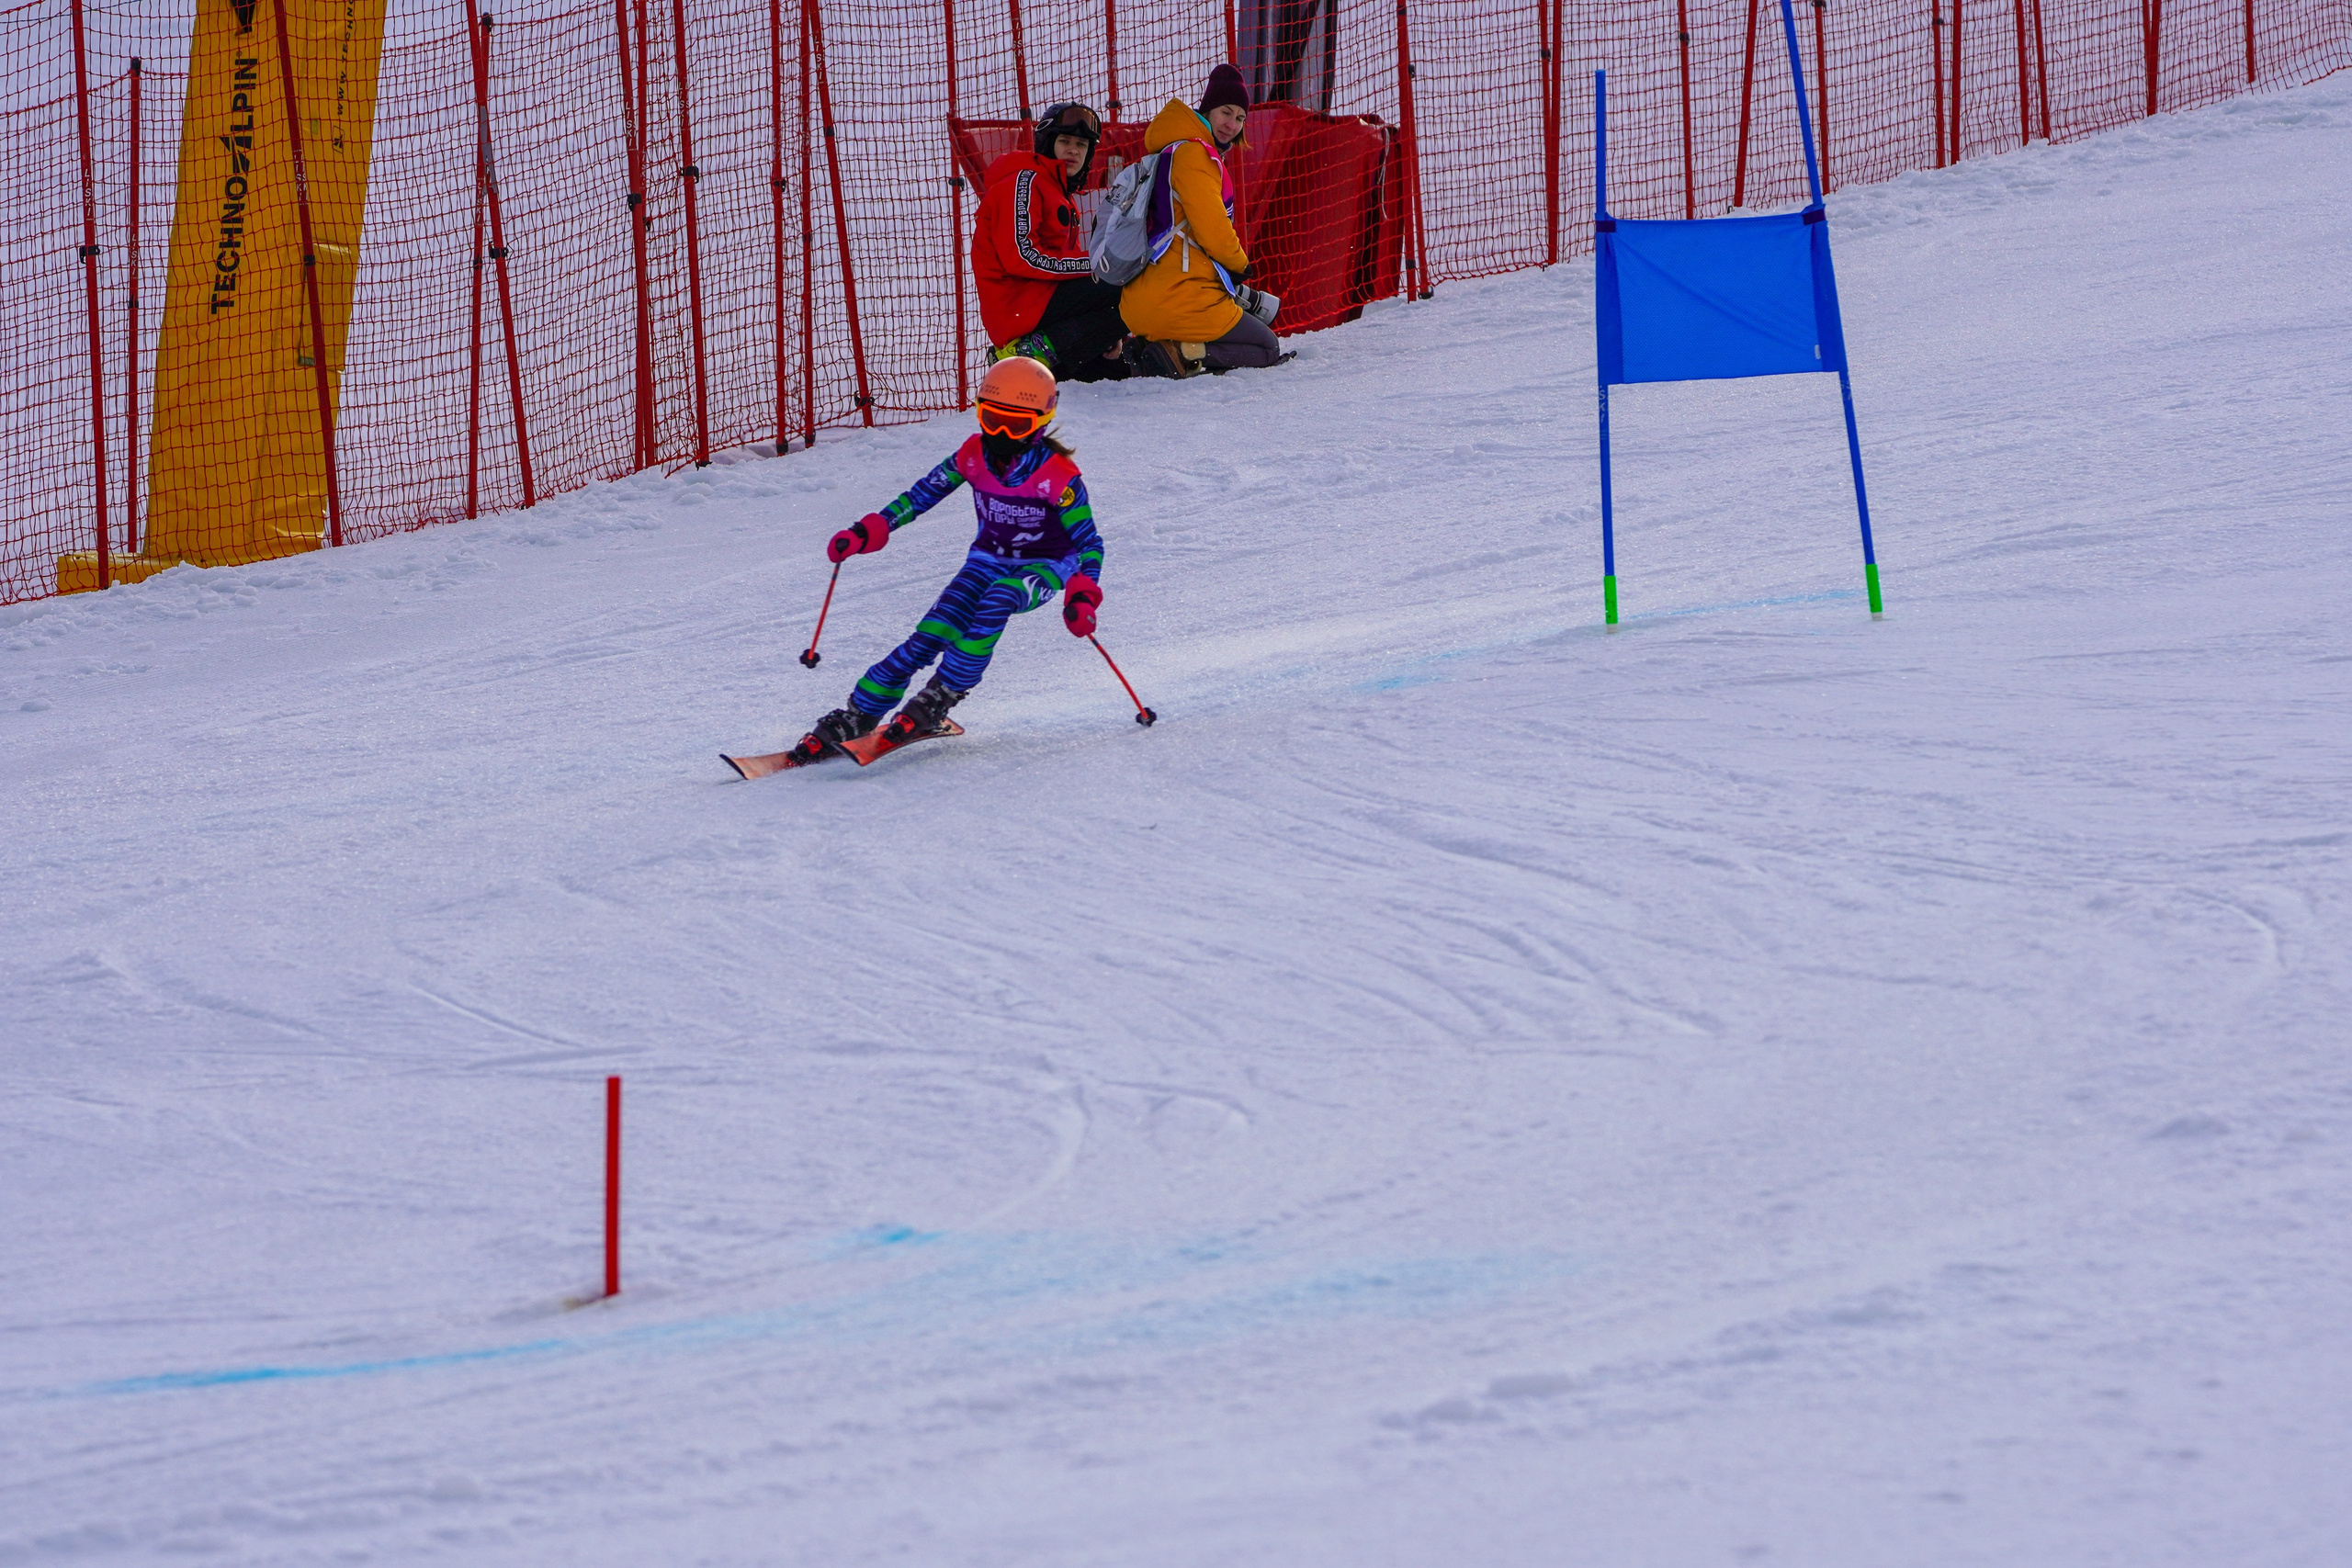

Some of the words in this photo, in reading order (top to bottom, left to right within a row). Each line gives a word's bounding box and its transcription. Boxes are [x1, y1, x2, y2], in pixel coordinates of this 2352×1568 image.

[626, 101, 634, 147] LISKI
[84, 168, 92, 217] LISKI
[130, 232, 138, 276] LISKI
[989, 511, 1016, 525] ГОРЫ
